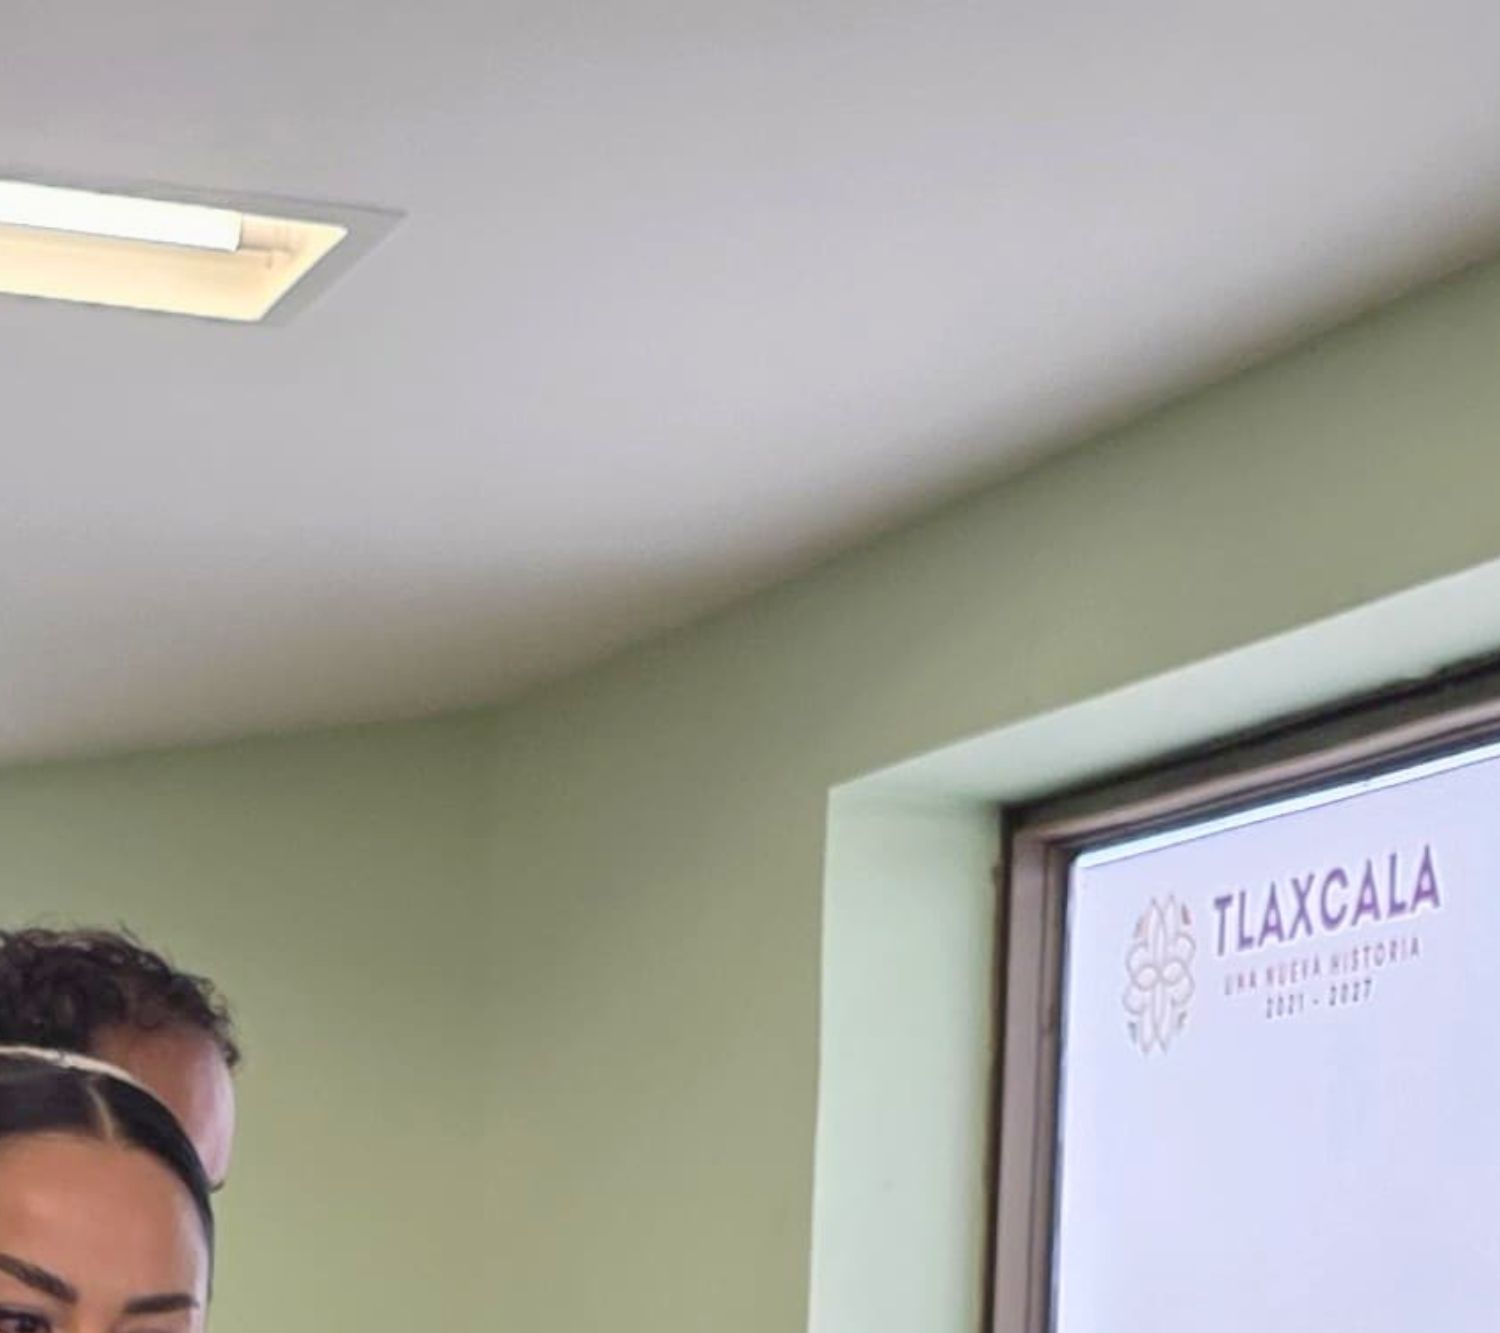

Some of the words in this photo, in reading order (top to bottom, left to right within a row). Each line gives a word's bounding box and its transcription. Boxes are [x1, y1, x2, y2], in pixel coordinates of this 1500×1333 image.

[1213, 843, 1441, 957] TLAXCALA
[1266, 953, 1321, 987] NUEVA
[1330, 937, 1420, 976] HISTORIA
[1266, 994, 1304, 1019] 2021
[1329, 977, 1373, 1007] 2027
